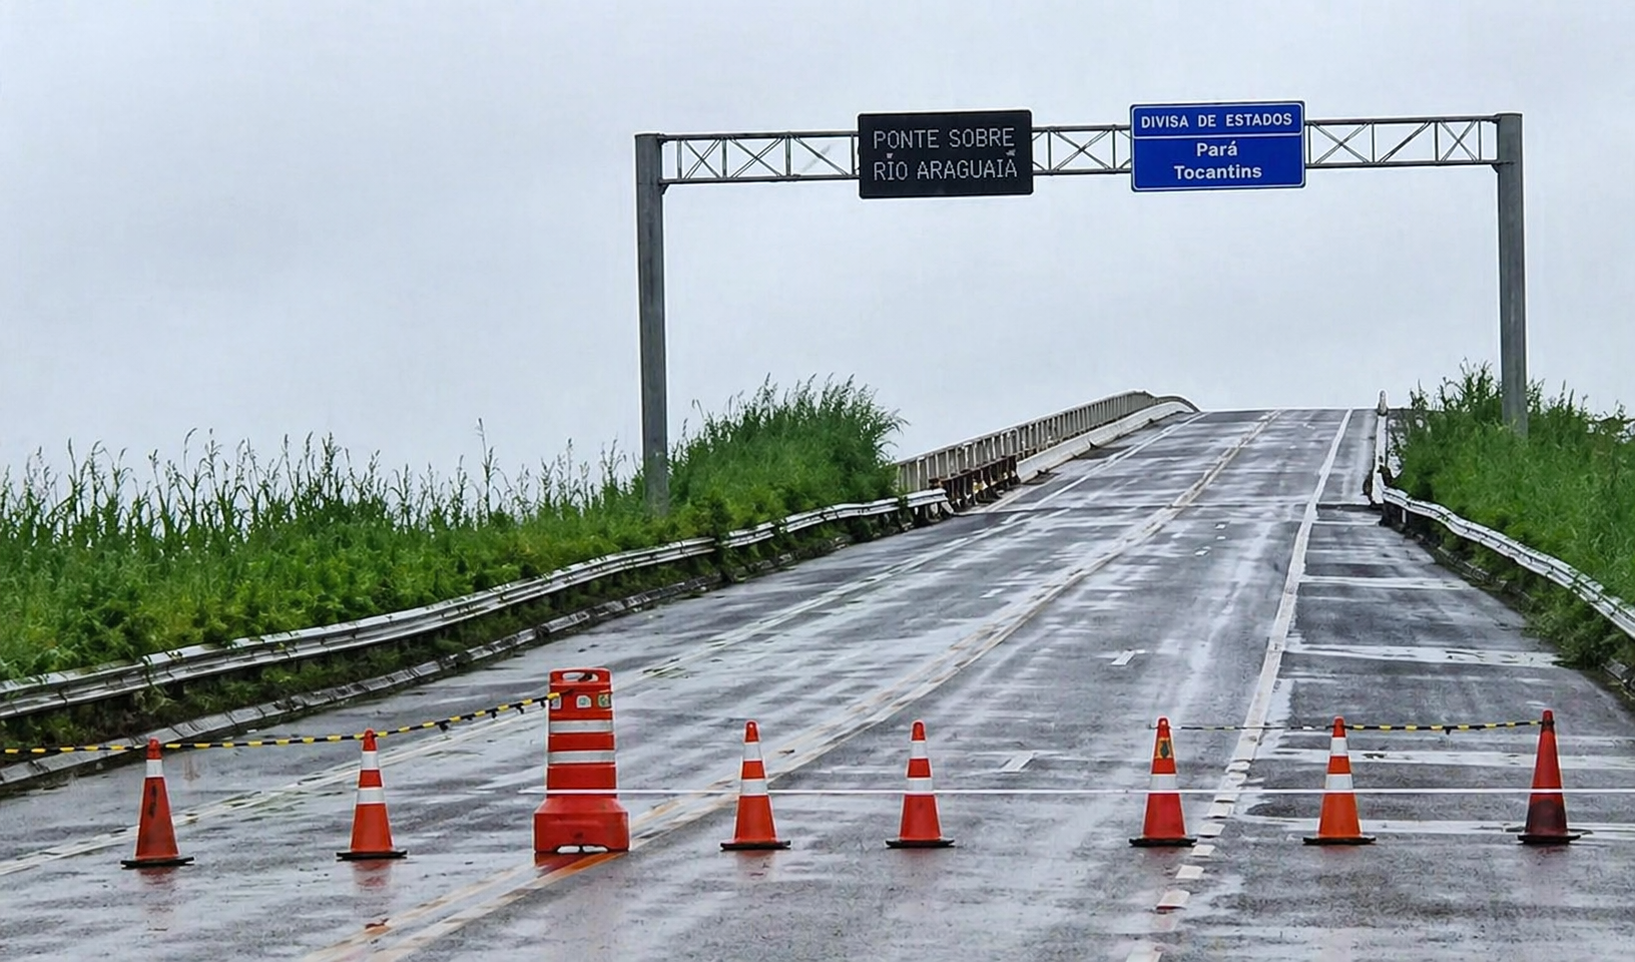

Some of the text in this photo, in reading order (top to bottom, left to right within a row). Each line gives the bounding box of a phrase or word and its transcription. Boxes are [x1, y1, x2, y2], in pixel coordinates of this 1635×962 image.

[1141, 113, 1293, 129] DIVISA DE ESTADOS
[873, 127, 1015, 149] PONTE SOBRE
[1196, 140, 1238, 157] Pará
[917, 159, 1018, 180] ARAGUAIA
[1174, 164, 1263, 180] Tocantins
